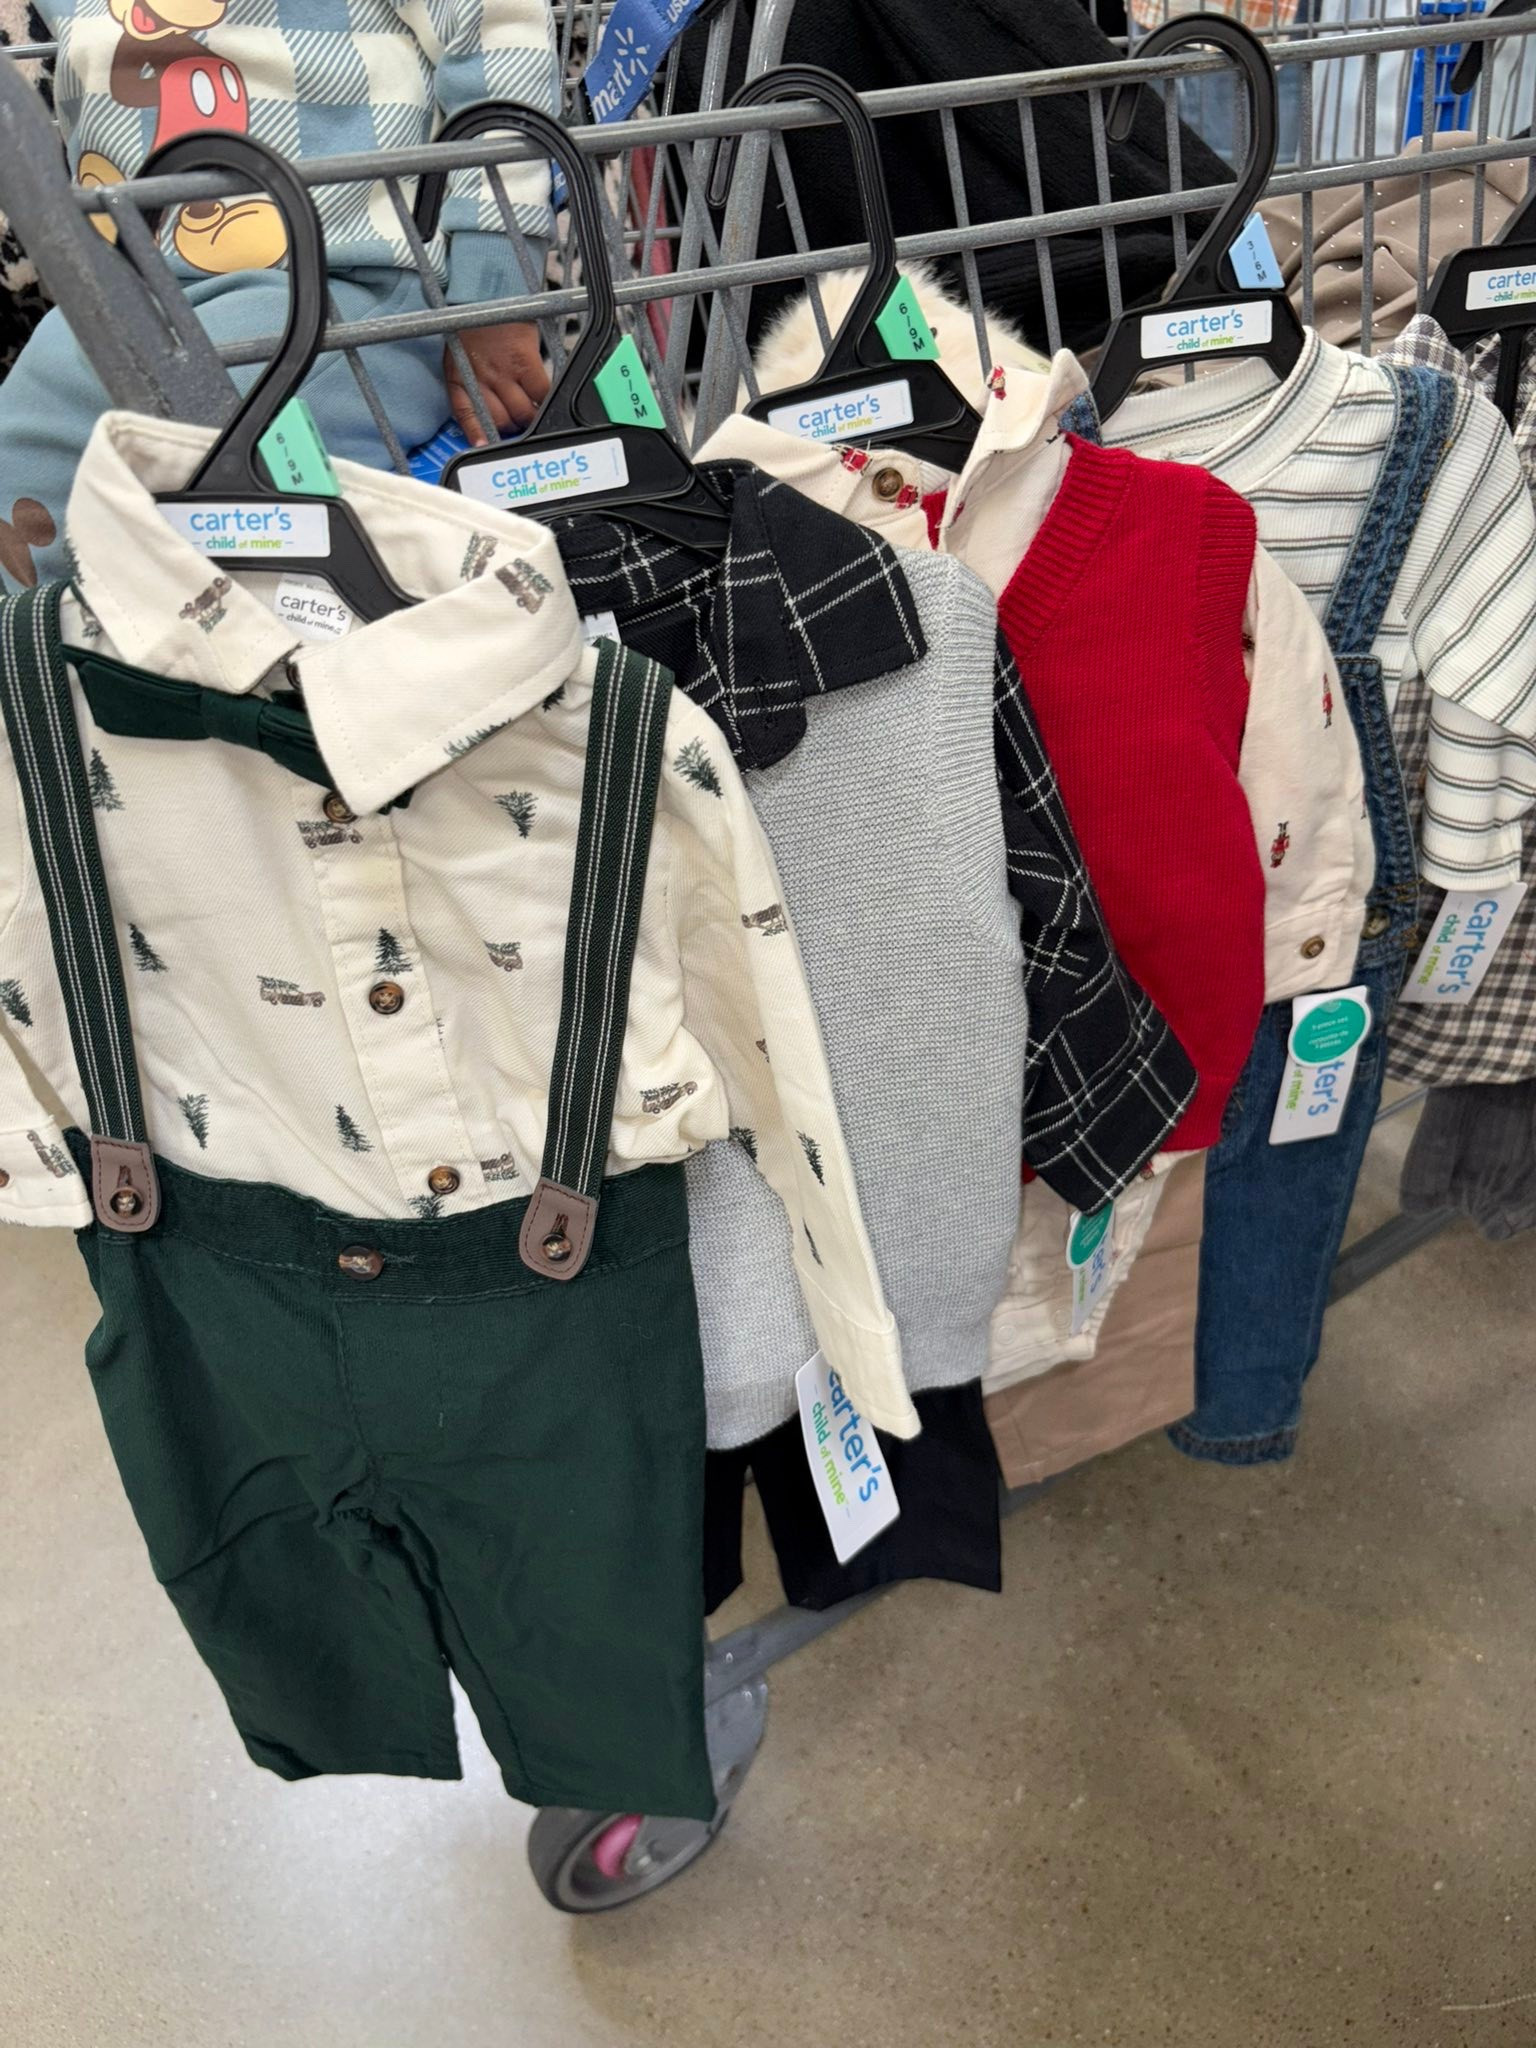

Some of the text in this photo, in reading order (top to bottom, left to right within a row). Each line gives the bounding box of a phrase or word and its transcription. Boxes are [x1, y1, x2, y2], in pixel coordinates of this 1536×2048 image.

[592, 59, 632, 124] mart
[1487, 270, 1536, 290] carter
[1166, 308, 1244, 337] carter's
[1176, 337, 1201, 351] child
[1210, 334, 1235, 346] mine
[798, 393, 881, 430] carter's
[811, 423, 837, 438] child
[847, 416, 873, 430] mine
[491, 450, 589, 489] carter's
[507, 482, 538, 500] child
[550, 476, 580, 490] mine
[190, 506, 293, 531] carter's
[206, 536, 236, 549] child
[250, 536, 282, 549] mine
[280, 595, 347, 621] carter's
[286, 613, 307, 624] child
[314, 620, 334, 632] mine
[1436, 913, 1461, 943] child
[1436, 899, 1499, 994] carter's
[1285, 1079, 1304, 1111] mine
[1307, 1060, 1345, 1117] ter's
[812, 1401, 831, 1445] child
[824, 1458, 847, 1505] mine
